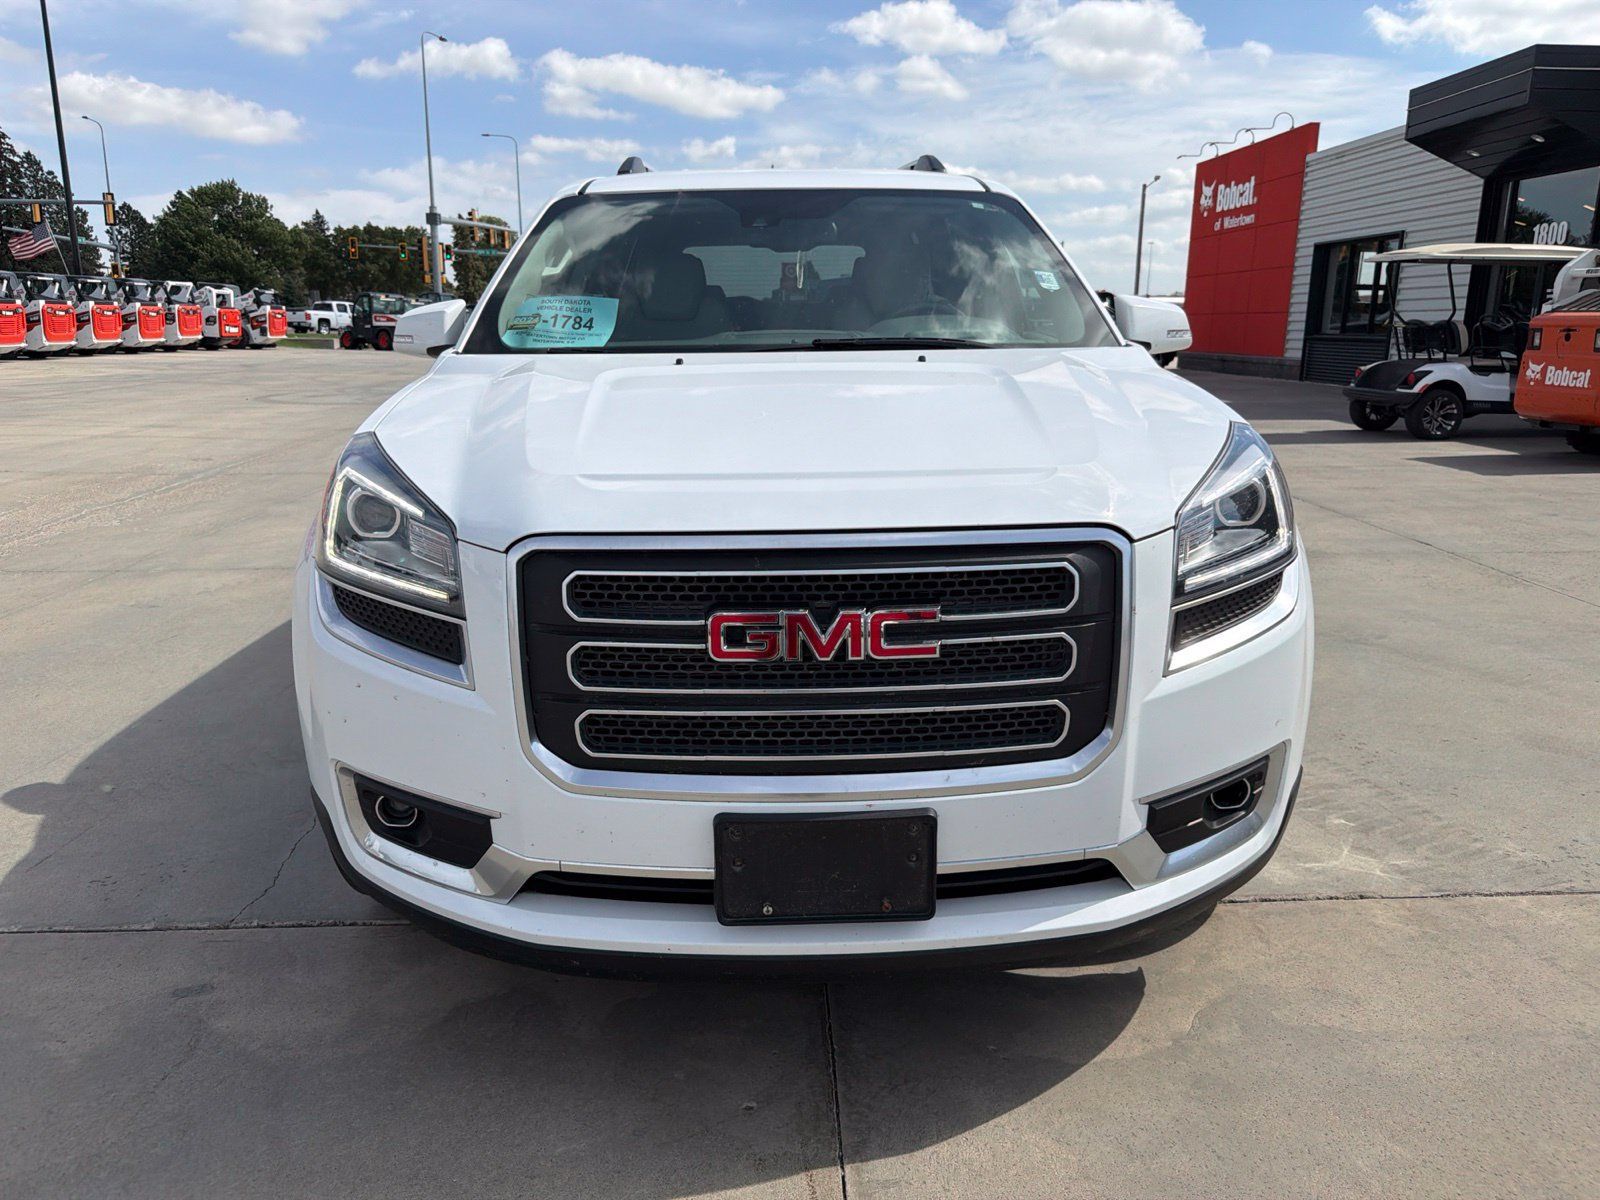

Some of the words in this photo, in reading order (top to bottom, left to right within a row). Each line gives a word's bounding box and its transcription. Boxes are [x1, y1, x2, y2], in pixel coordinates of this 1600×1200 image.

[1216, 175, 1256, 213] Bobcat
[1213, 218, 1222, 231] of
[1223, 213, 1255, 230] Watertown
[1533, 220, 1568, 245] 1800
[1544, 365, 1591, 388] Bobcat
[707, 604, 941, 662] GMC
